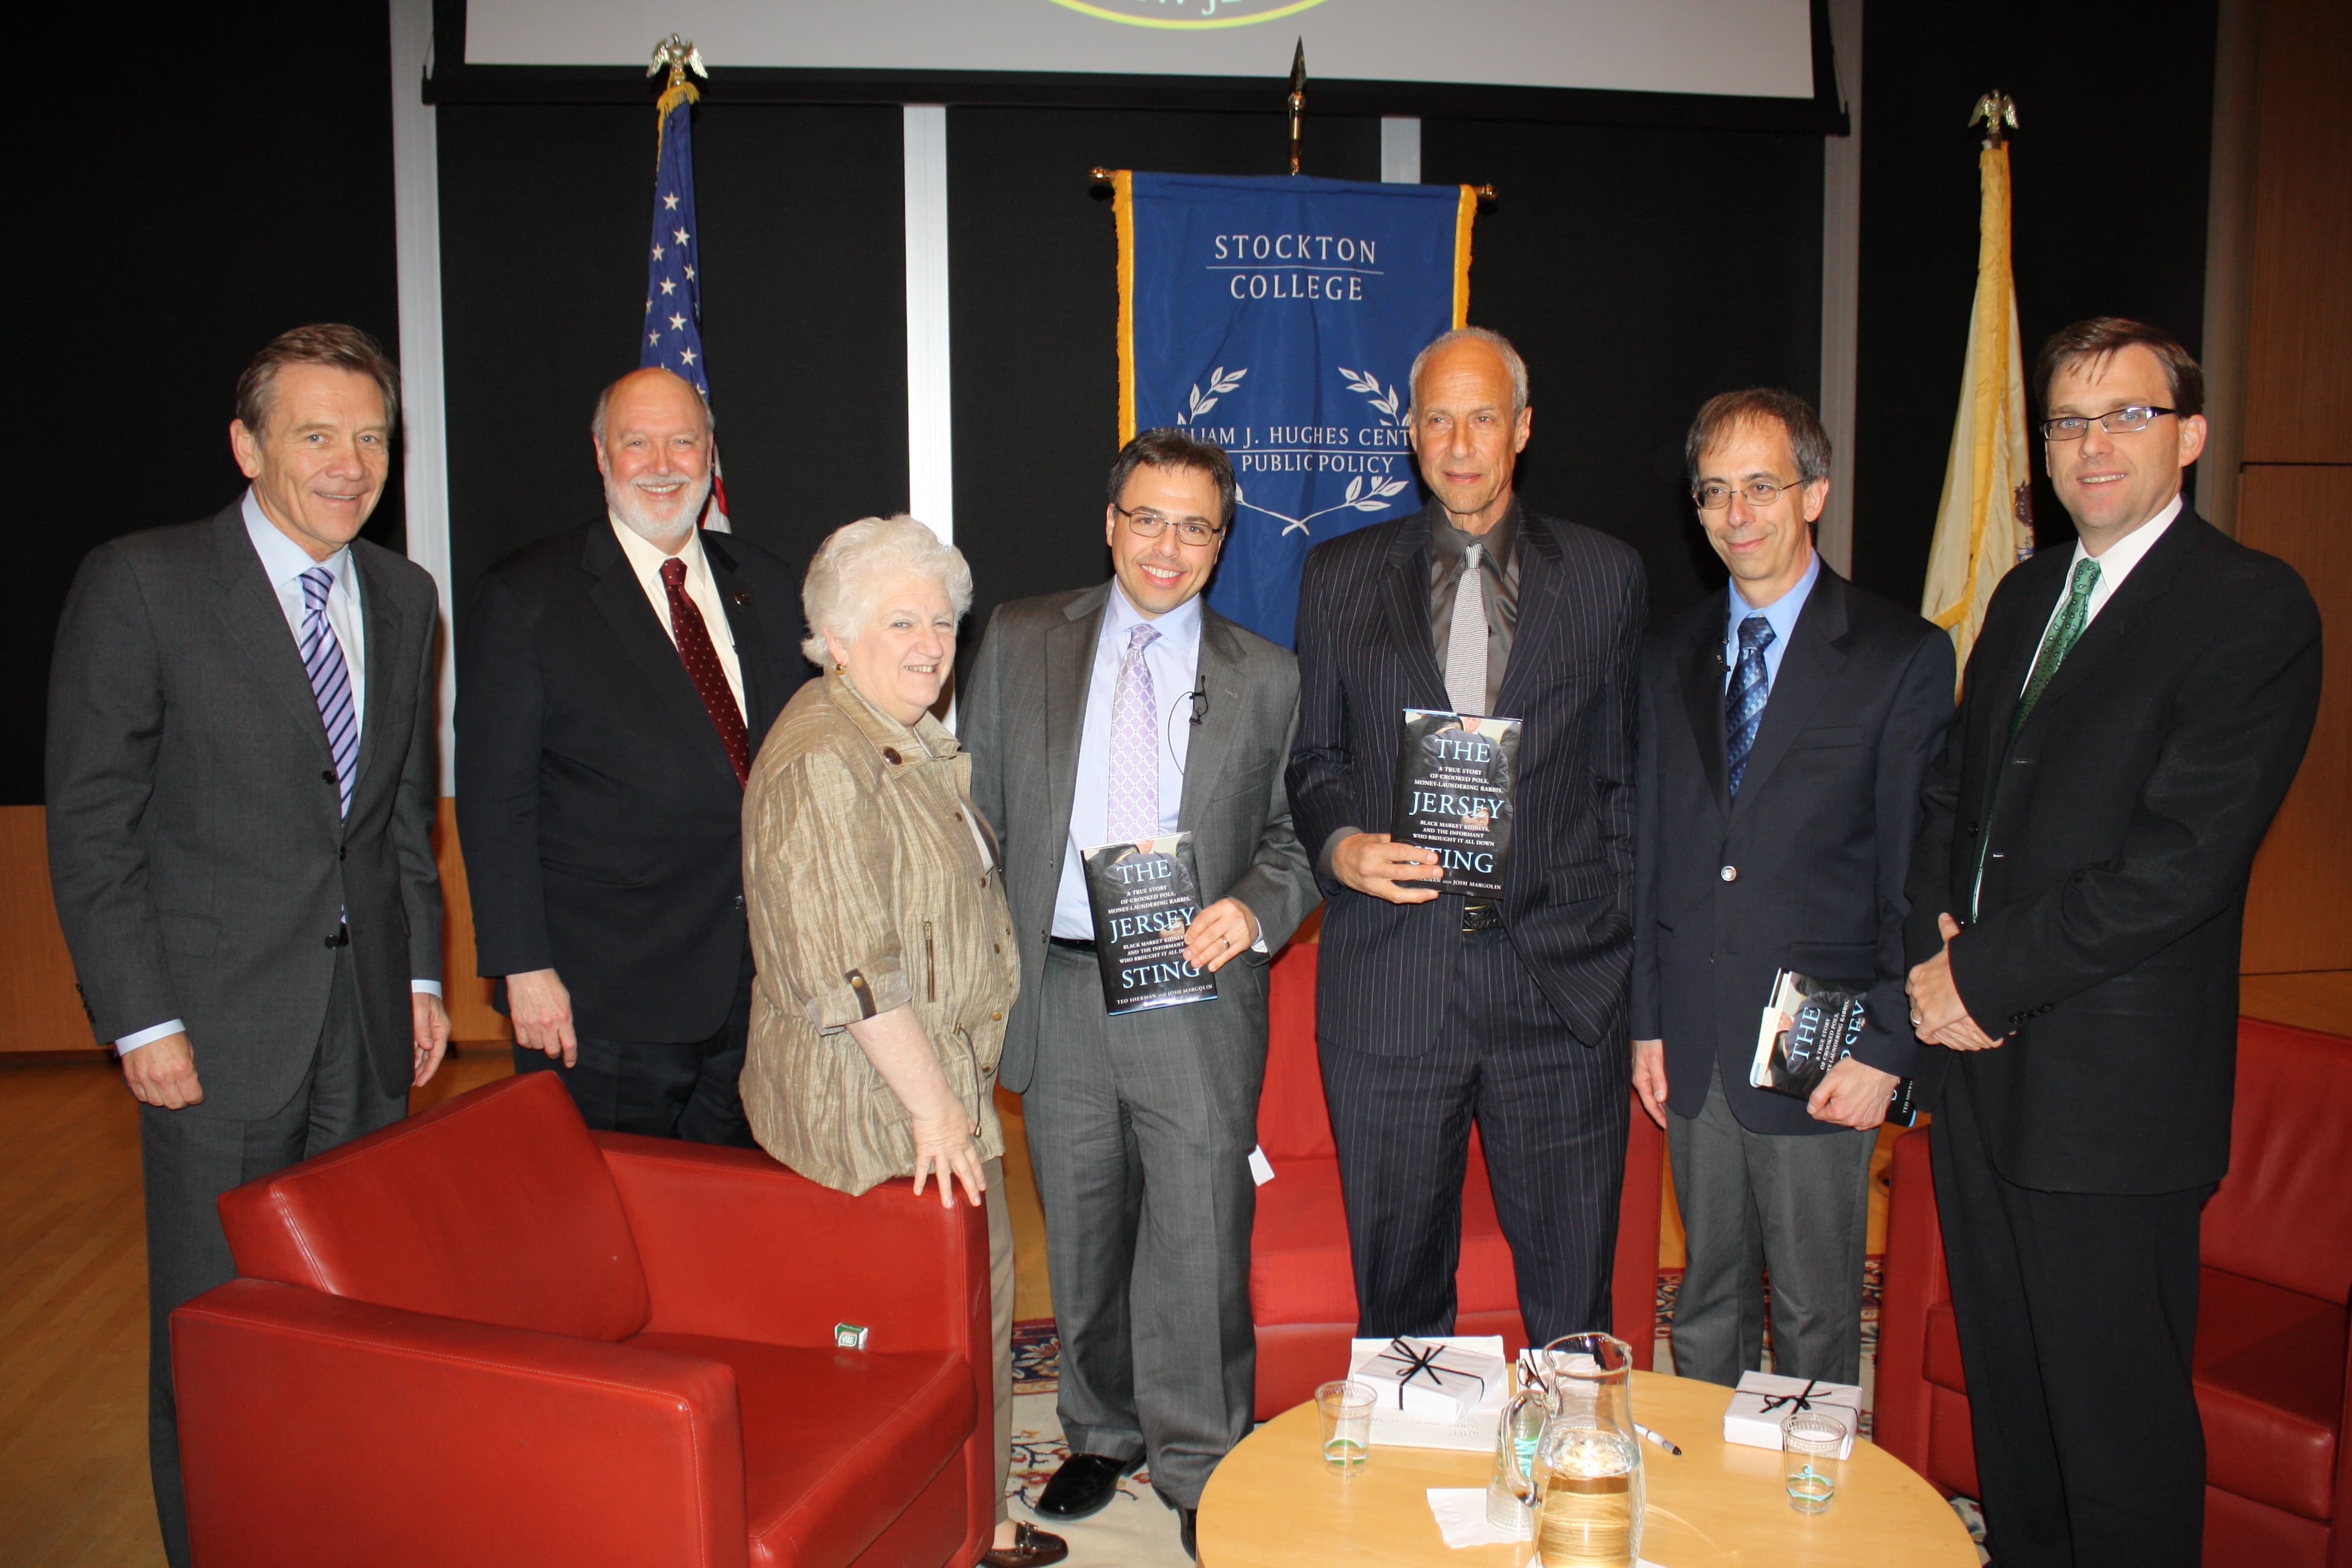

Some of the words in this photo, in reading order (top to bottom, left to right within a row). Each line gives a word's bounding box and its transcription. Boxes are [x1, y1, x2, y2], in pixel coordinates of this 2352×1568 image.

[1215, 235, 1376, 264] STOCKTON
[1230, 275, 1363, 300] COLLEGE
[1243, 427, 1259, 449] J.
[1270, 426, 1349, 445] HUGHES
[1242, 454, 1313, 472] PUBLIC
[1319, 455, 1393, 473] POLICY
[1434, 738, 1491, 763] THE
[1414, 779, 1479, 791] MONEY-LAUNDERING
[1440, 774, 1471, 782] CROOKED
[1408, 791, 1505, 819] JERSEY
[1428, 834, 1457, 843] BROUGHT
[1116, 859, 1172, 884] THE
[1108, 900, 1168, 914] MONEY-LAUNDERING
[1129, 894, 1158, 903] CROOKED
[1109, 906, 1195, 943] JERSEY
[1141, 938, 1163, 947] MARKET
[1152, 941, 1184, 951] INFORMANT
[1134, 952, 1160, 961] BROUGHT
[1122, 959, 1200, 988] STING
[1129, 994, 1157, 1003] SHERMAN
[1183, 984, 1212, 993] MARGOLIN
[1791, 1007, 1820, 1062] THE
[1817, 1037, 1825, 1055] TRUE
[1821, 1018, 1831, 1038] STORY
[1820, 1060, 1826, 1070] OF
[1823, 1030, 1834, 1060] CROOKED
